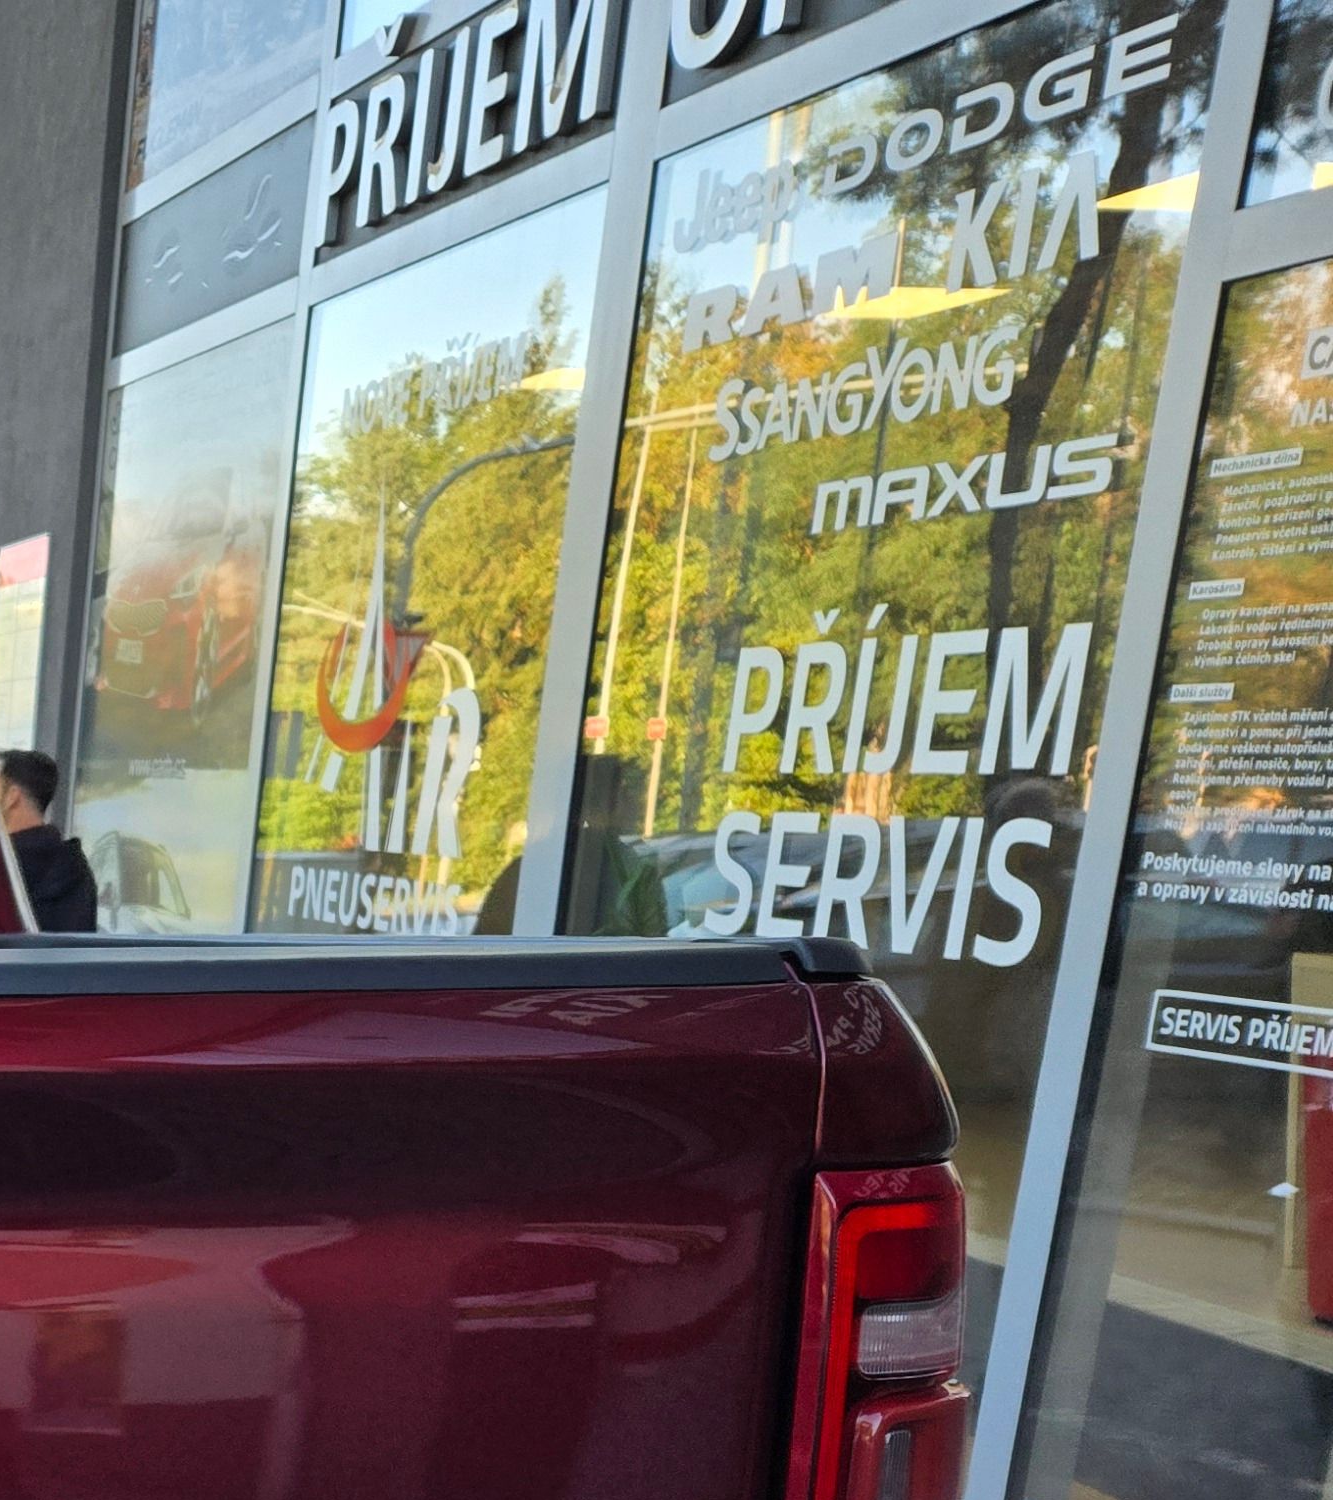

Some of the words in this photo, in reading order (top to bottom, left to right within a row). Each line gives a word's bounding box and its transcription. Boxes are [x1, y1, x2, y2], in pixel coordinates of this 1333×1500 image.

[674, 160, 796, 253] Jeep
[824, 13, 1178, 197] DODGE
[683, 233, 898, 353] RAM
[946, 150, 1099, 293] KIA
[709, 326, 1019, 462] SSANGYONG
[811, 433, 1118, 535] MAXUS
[723, 603, 1093, 775] PŘÍJEM
[1173, 686, 1196, 698] Další
[1199, 685, 1231, 699] služby
[1231, 711, 1251, 721] STK
[1254, 709, 1287, 722] včetně
[1290, 708, 1328, 721] měření
[1249, 729, 1283, 740] pomoc
[1286, 726, 1302, 740] při
[1218, 757, 1253, 770] střešní
[1232, 742, 1271, 754] veškeré
[1233, 773, 1285, 787] přestavby
[1288, 774, 1325, 786] vozidel
[1143, 852, 1253, 876] Poskytujeme
[1258, 858, 1304, 883] slevy
[1308, 864, 1332, 881] na
[288, 866, 461, 935] PNEUSERVIS
[704, 812, 1053, 967] SERVIS
[1137, 882, 1148, 896] a
[1152, 882, 1210, 904] opravy
[1214, 886, 1225, 900] v
[1228, 882, 1313, 909] závislosti
[1160, 1007, 1242, 1044] SERVIS
[1247, 1013, 1333, 1058] PŘÍJEM
